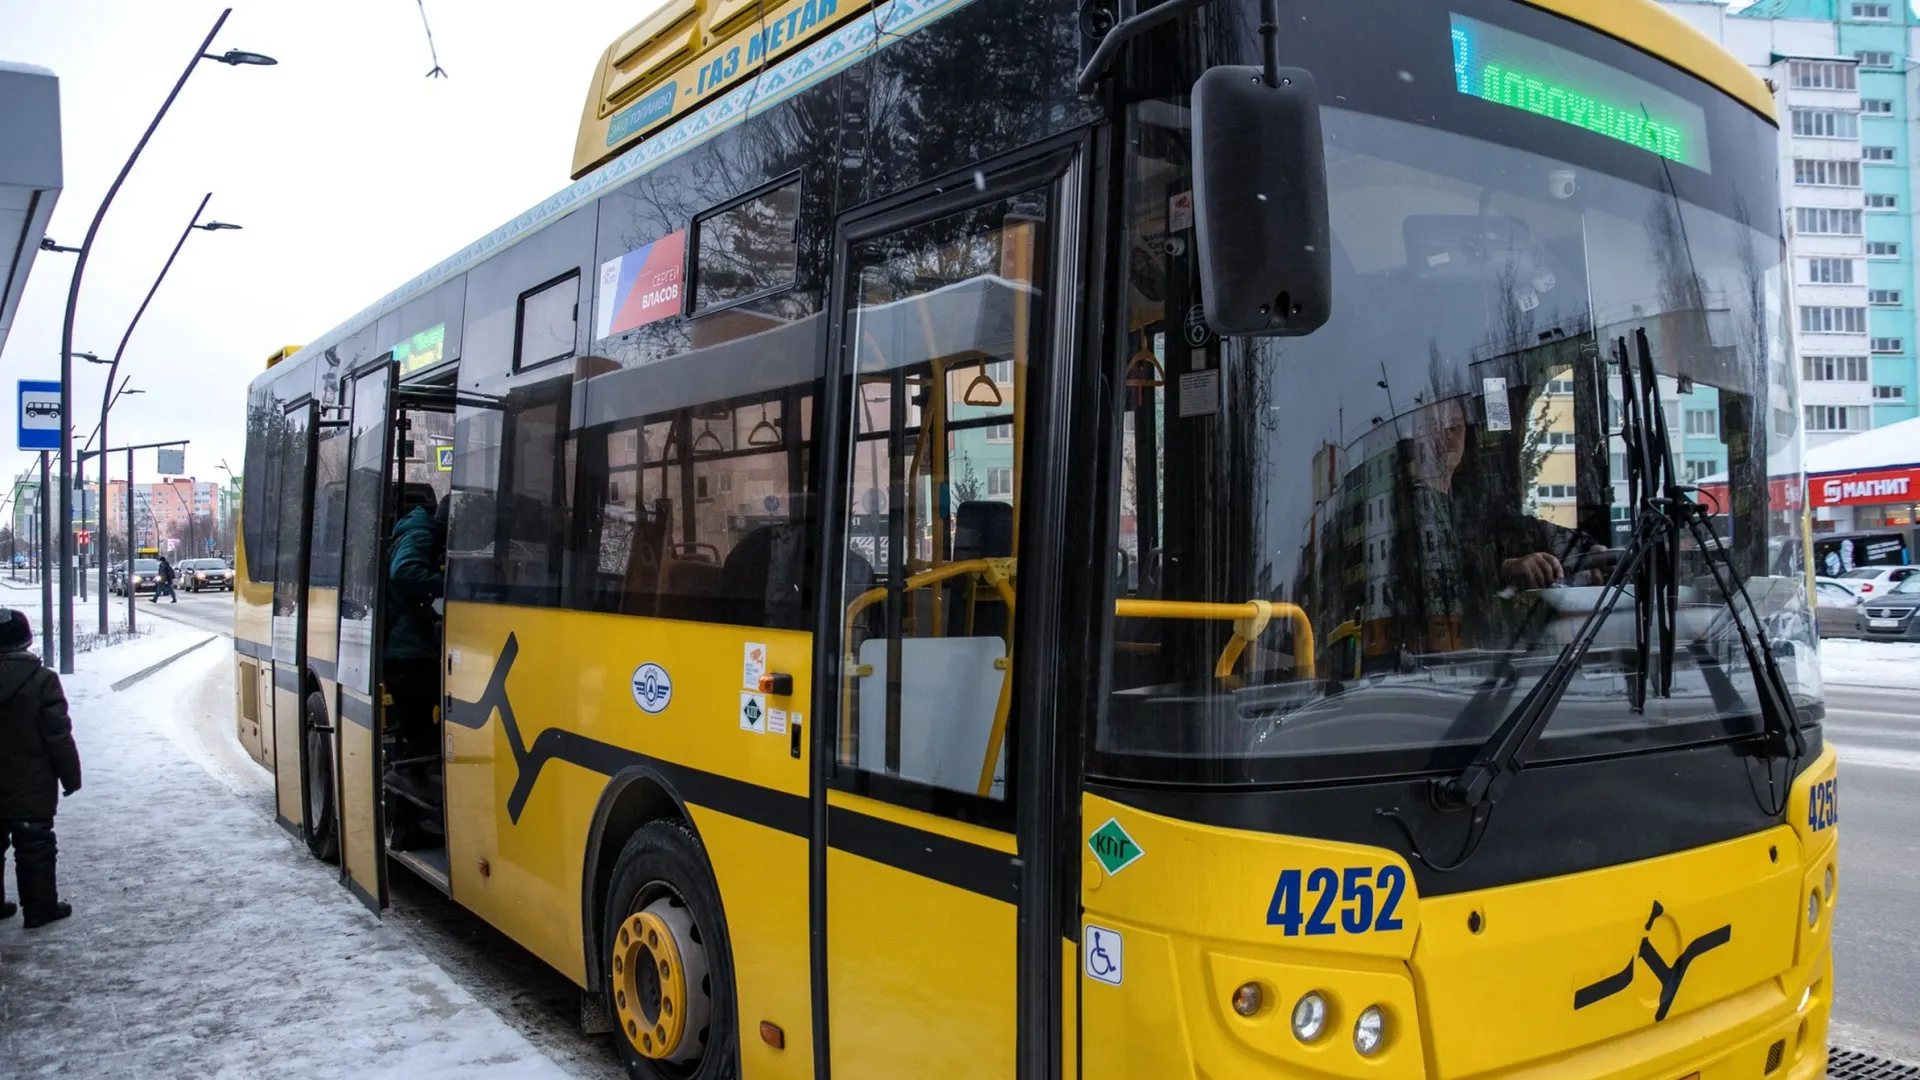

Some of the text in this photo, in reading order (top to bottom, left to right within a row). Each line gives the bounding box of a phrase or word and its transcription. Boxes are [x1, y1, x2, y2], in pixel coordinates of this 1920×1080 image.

[696, 45, 742, 97] ГАЗ
[652, 264, 680, 288] СЕРГЕЙ
[642, 284, 679, 309] ВЛАСОВ
[1843, 477, 1910, 498] МАГНИТ
[1095, 833, 1131, 859] КПГ
[1266, 865, 1407, 937] 4252
